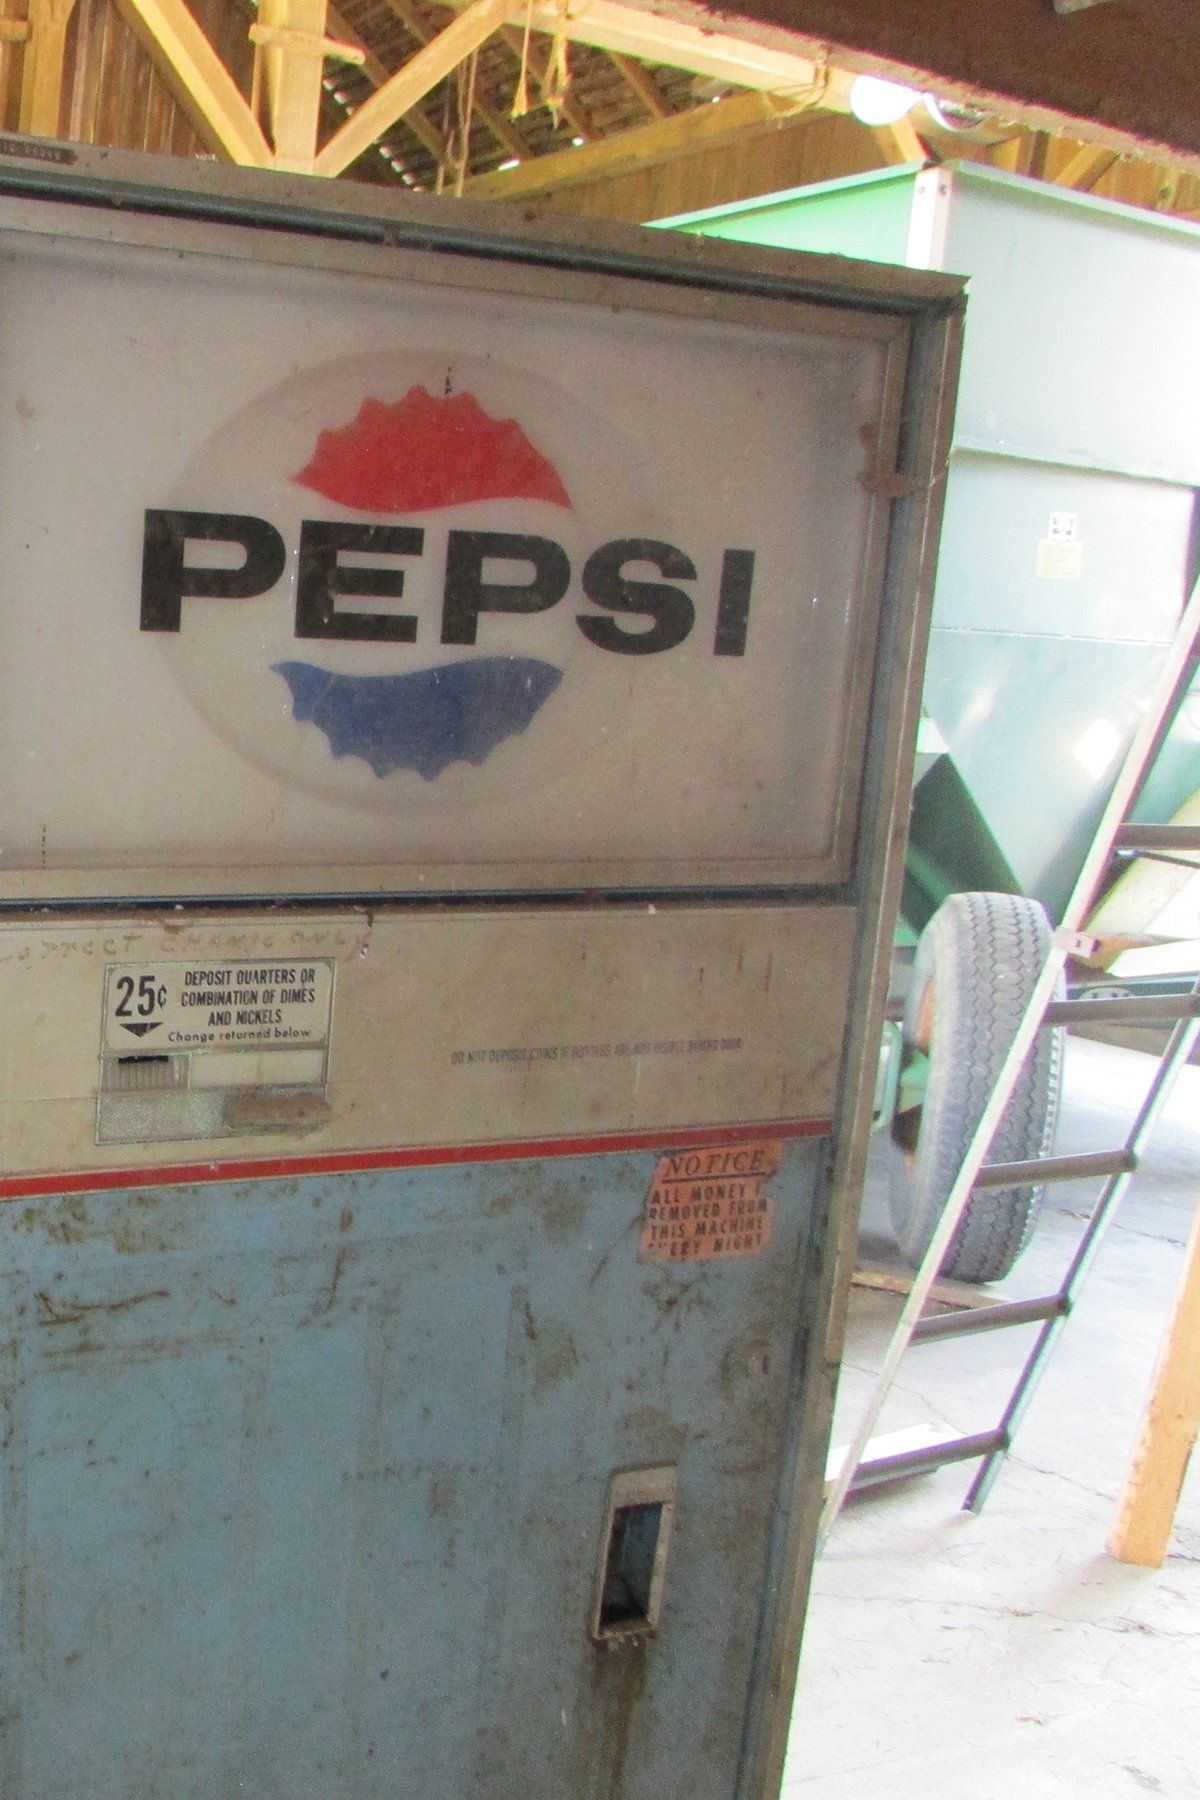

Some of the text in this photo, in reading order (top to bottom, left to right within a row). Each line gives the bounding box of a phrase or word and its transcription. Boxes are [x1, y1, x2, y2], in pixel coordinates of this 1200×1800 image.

[140, 508, 755, 657] PEPSI
[185, 968, 316, 986] DEPOSIT QUARTERS OR
[181, 988, 316, 1007] COMBINATION OF DIMES
[208, 1009, 282, 1027] AND NICKELS
[168, 1026, 311, 1043] Change returned below
[664, 1151, 766, 1177] NOTICE
[651, 1188, 681, 1205] ALL
[691, 1184, 747, 1201] MONEY
[650, 1198, 768, 1220] REMOVED FROM
[651, 1216, 763, 1240] THIS MACHINE
[714, 1232, 761, 1252] NIGHT
